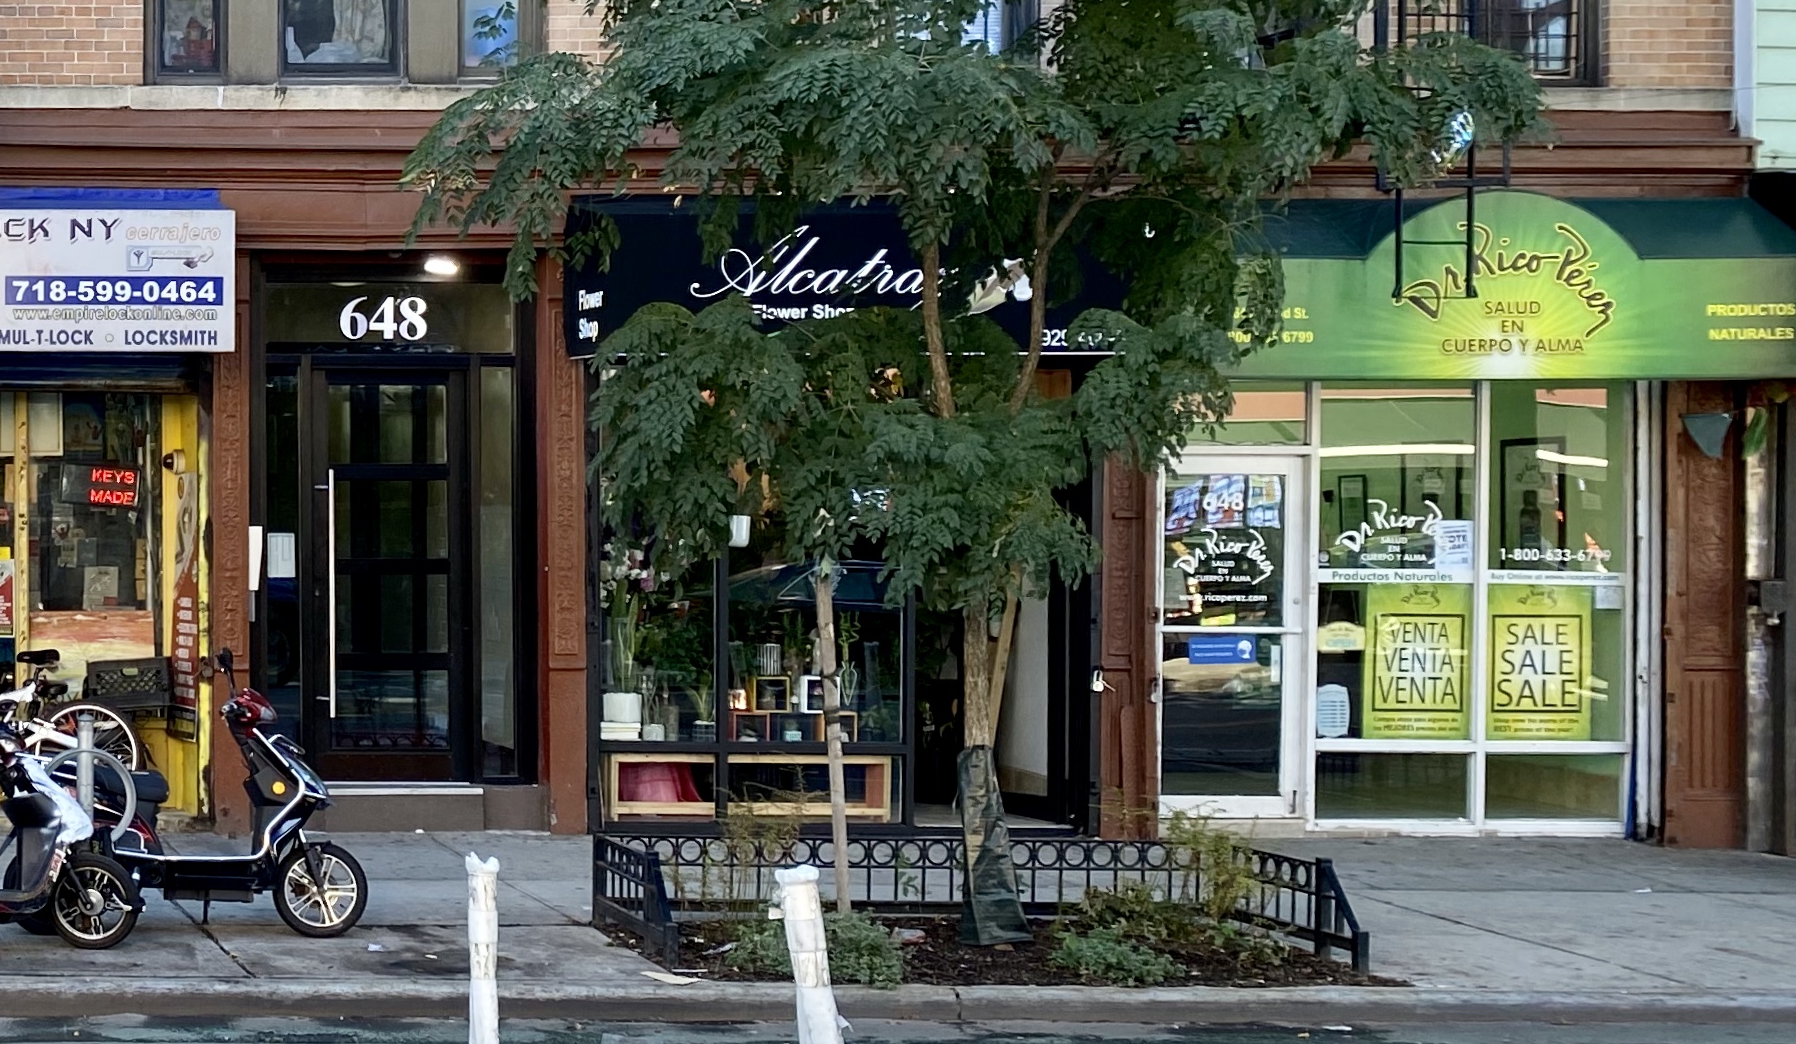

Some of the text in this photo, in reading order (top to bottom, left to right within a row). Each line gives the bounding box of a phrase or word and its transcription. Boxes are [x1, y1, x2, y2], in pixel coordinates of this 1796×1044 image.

[69, 217, 121, 244] NY
[125, 223, 222, 244] cerrajero
[690, 225, 957, 312] Alcatra
[12, 280, 216, 302] 718-599-0464
[578, 289, 604, 312] Flower
[1484, 301, 1542, 316] SALUD
[12, 306, 218, 323] www.empirelockonline.com
[339, 296, 428, 341] 648
[752, 304, 808, 320] Flower
[1293, 307, 1310, 319] St.
[1707, 304, 1796, 318] PRODUCTOS
[578, 317, 600, 341] Shop
[1501, 320, 1525, 334] EN
[1708, 326, 1795, 340] NATURALES
[124, 329, 218, 346] LOCKSMITH
[1282, 331, 1314, 343] 6799
[1441, 337, 1584, 353] CUERPO Y ALMA
[92, 468, 135, 485] KEYS
[89, 489, 135, 505] MADE
[1204, 493, 1244, 512] 648
[1335, 499, 1425, 553] Dr. Rico
[1388, 545, 1401, 553] EN
[1500, 548, 1612, 562] 1-800-633-6799
[1361, 554, 1394, 562] CUERPO
[1403, 554, 1427, 562] ALMA
[1332, 571, 1453, 582] Productos Naturales
[1391, 622, 1450, 644] VENTA
[1507, 623, 1569, 646] SALE
[1385, 648, 1455, 674] VENTA
[1501, 650, 1575, 676] SALE
[1378, 676, 1458, 704] VENTA
[1496, 679, 1578, 708] SALE
